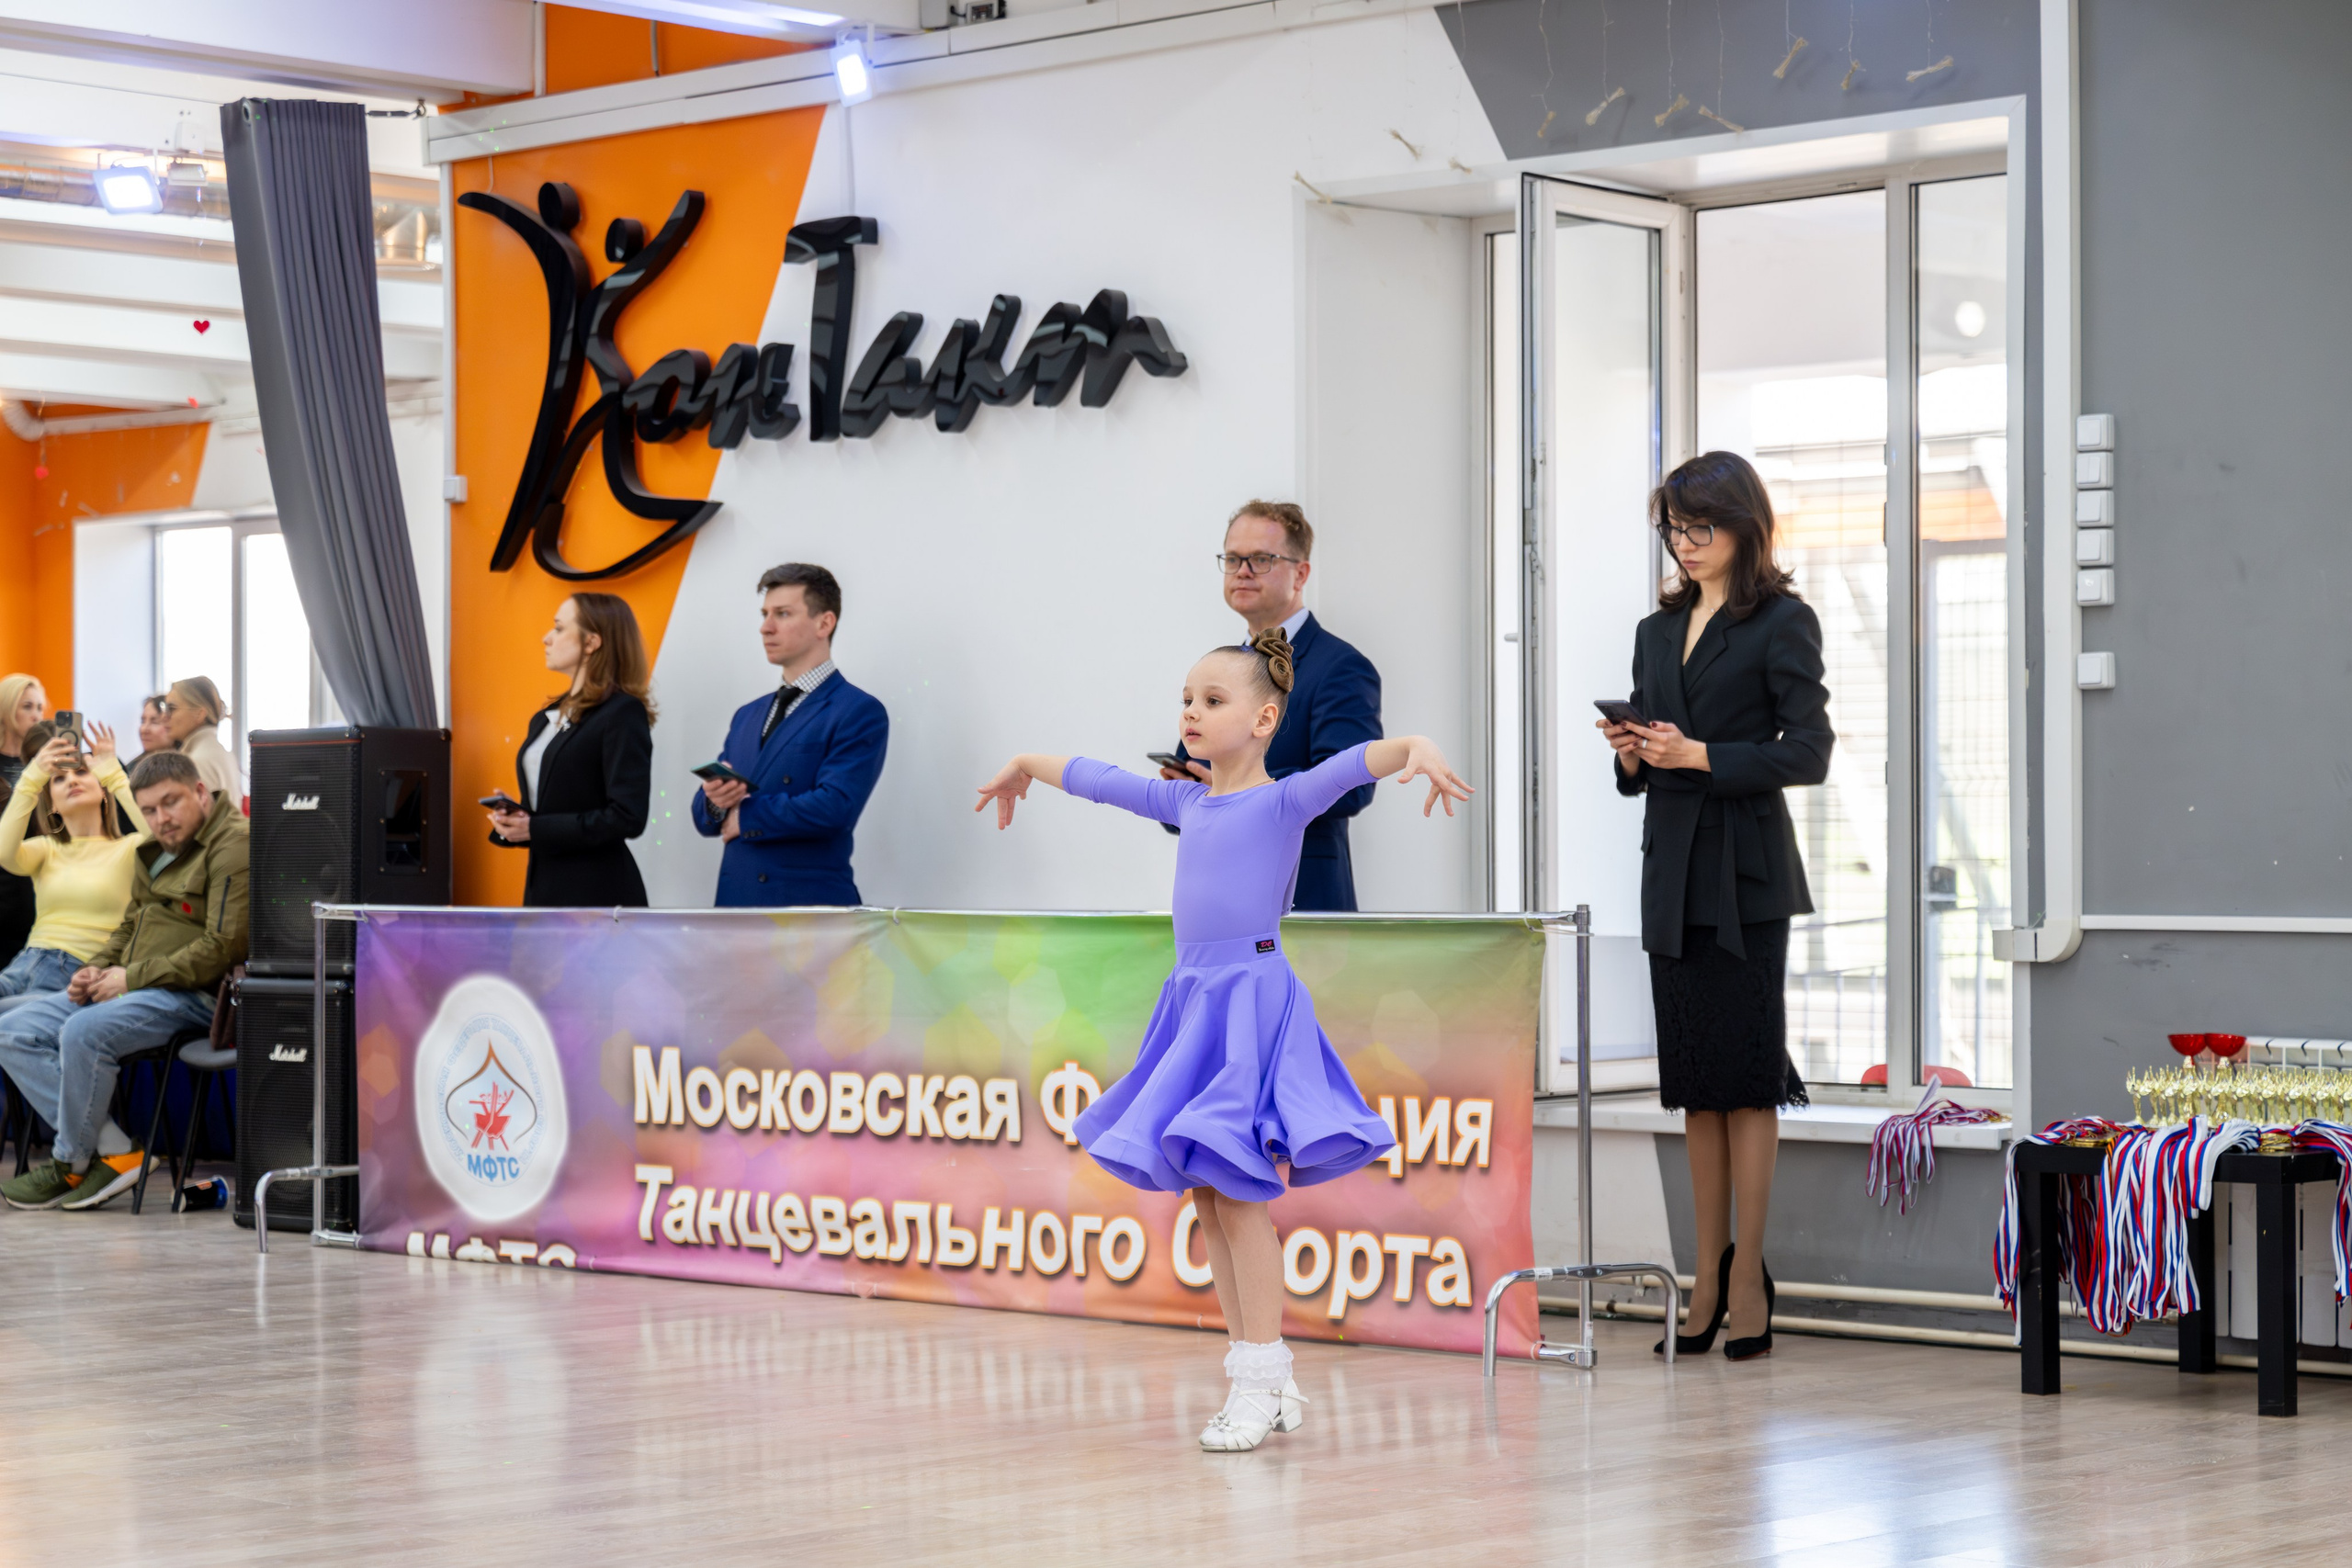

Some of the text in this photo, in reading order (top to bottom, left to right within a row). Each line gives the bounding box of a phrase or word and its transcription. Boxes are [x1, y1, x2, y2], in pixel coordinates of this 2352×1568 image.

[632, 1045, 1023, 1143] Московская
[467, 1153, 521, 1182] МФТС
[634, 1163, 1474, 1320] Танцевального Сорта
